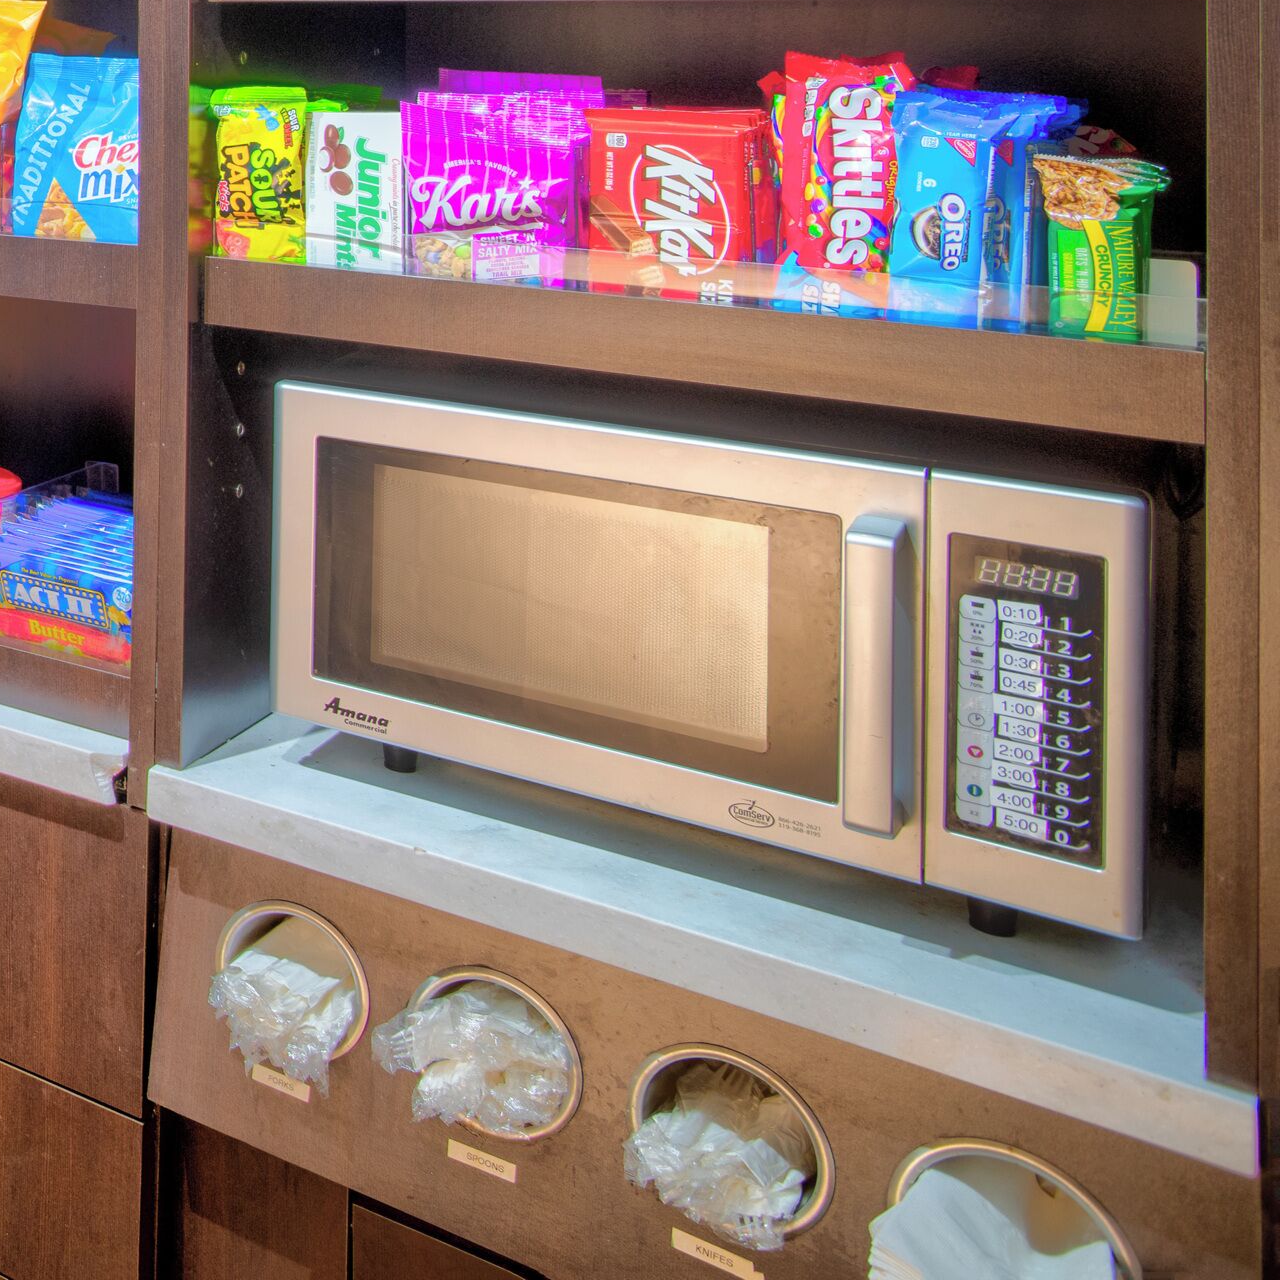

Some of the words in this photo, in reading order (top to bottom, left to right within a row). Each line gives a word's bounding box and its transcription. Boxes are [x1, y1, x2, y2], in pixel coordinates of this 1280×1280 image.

[288, 109, 299, 131] SOUR
[12, 82, 90, 226] TRADITIONAL
[485, 160, 518, 178] FAVORITE
[826, 86, 884, 265] Skittles
[223, 143, 260, 229] PATCH
[251, 148, 282, 223] SOUR
[356, 137, 387, 259] Junior
[412, 175, 543, 229] Kar's
[336, 203, 357, 269] Mints
[480, 234, 518, 246] SWEET
[938, 193, 967, 271] OREO
[478, 245, 512, 258] SALTY
[515, 243, 537, 254] MIX
[1105, 225, 1134, 278] NATURE
[1095, 244, 1112, 307] CRUNCHY
[14, 583, 59, 610] ACT
[64, 594, 95, 618] II
[1002, 605, 1037, 621] 0:10
[29, 619, 85, 645] Butter
[1060, 616, 1072, 631] 1
[1004, 627, 1038, 644] 0:20
[1057, 640, 1072, 655] 2
[1003, 654, 1038, 670] 0:30
[1057, 663, 1072, 678] 3
[1002, 676, 1037, 692] 0:45
[1056, 688, 1072, 703] 4
[323, 696, 389, 727] Amana
[1001, 701, 1035, 717] 1:00
[344, 718, 387, 734] Commercial
[1057, 711, 1072, 726] 5
[1003, 722, 1037, 739] 1:30
[1055, 735, 1071, 750] 6
[999, 744, 1034, 761] 2:00
[1056, 758, 1071, 772] 7
[997, 766, 1032, 783] 3:00
[1055, 781, 1071, 797] 8
[997, 792, 1032, 809] 4:00
[733, 806, 771, 822] ComServ
[1055, 804, 1071, 820] 9
[1003, 814, 1039, 834] 5:00
[1055, 830, 1071, 846] 0
[267, 1074, 294, 1092] FORKS
[466, 1152, 504, 1174] SPOONS
[695, 1245, 734, 1268] KNIFES
